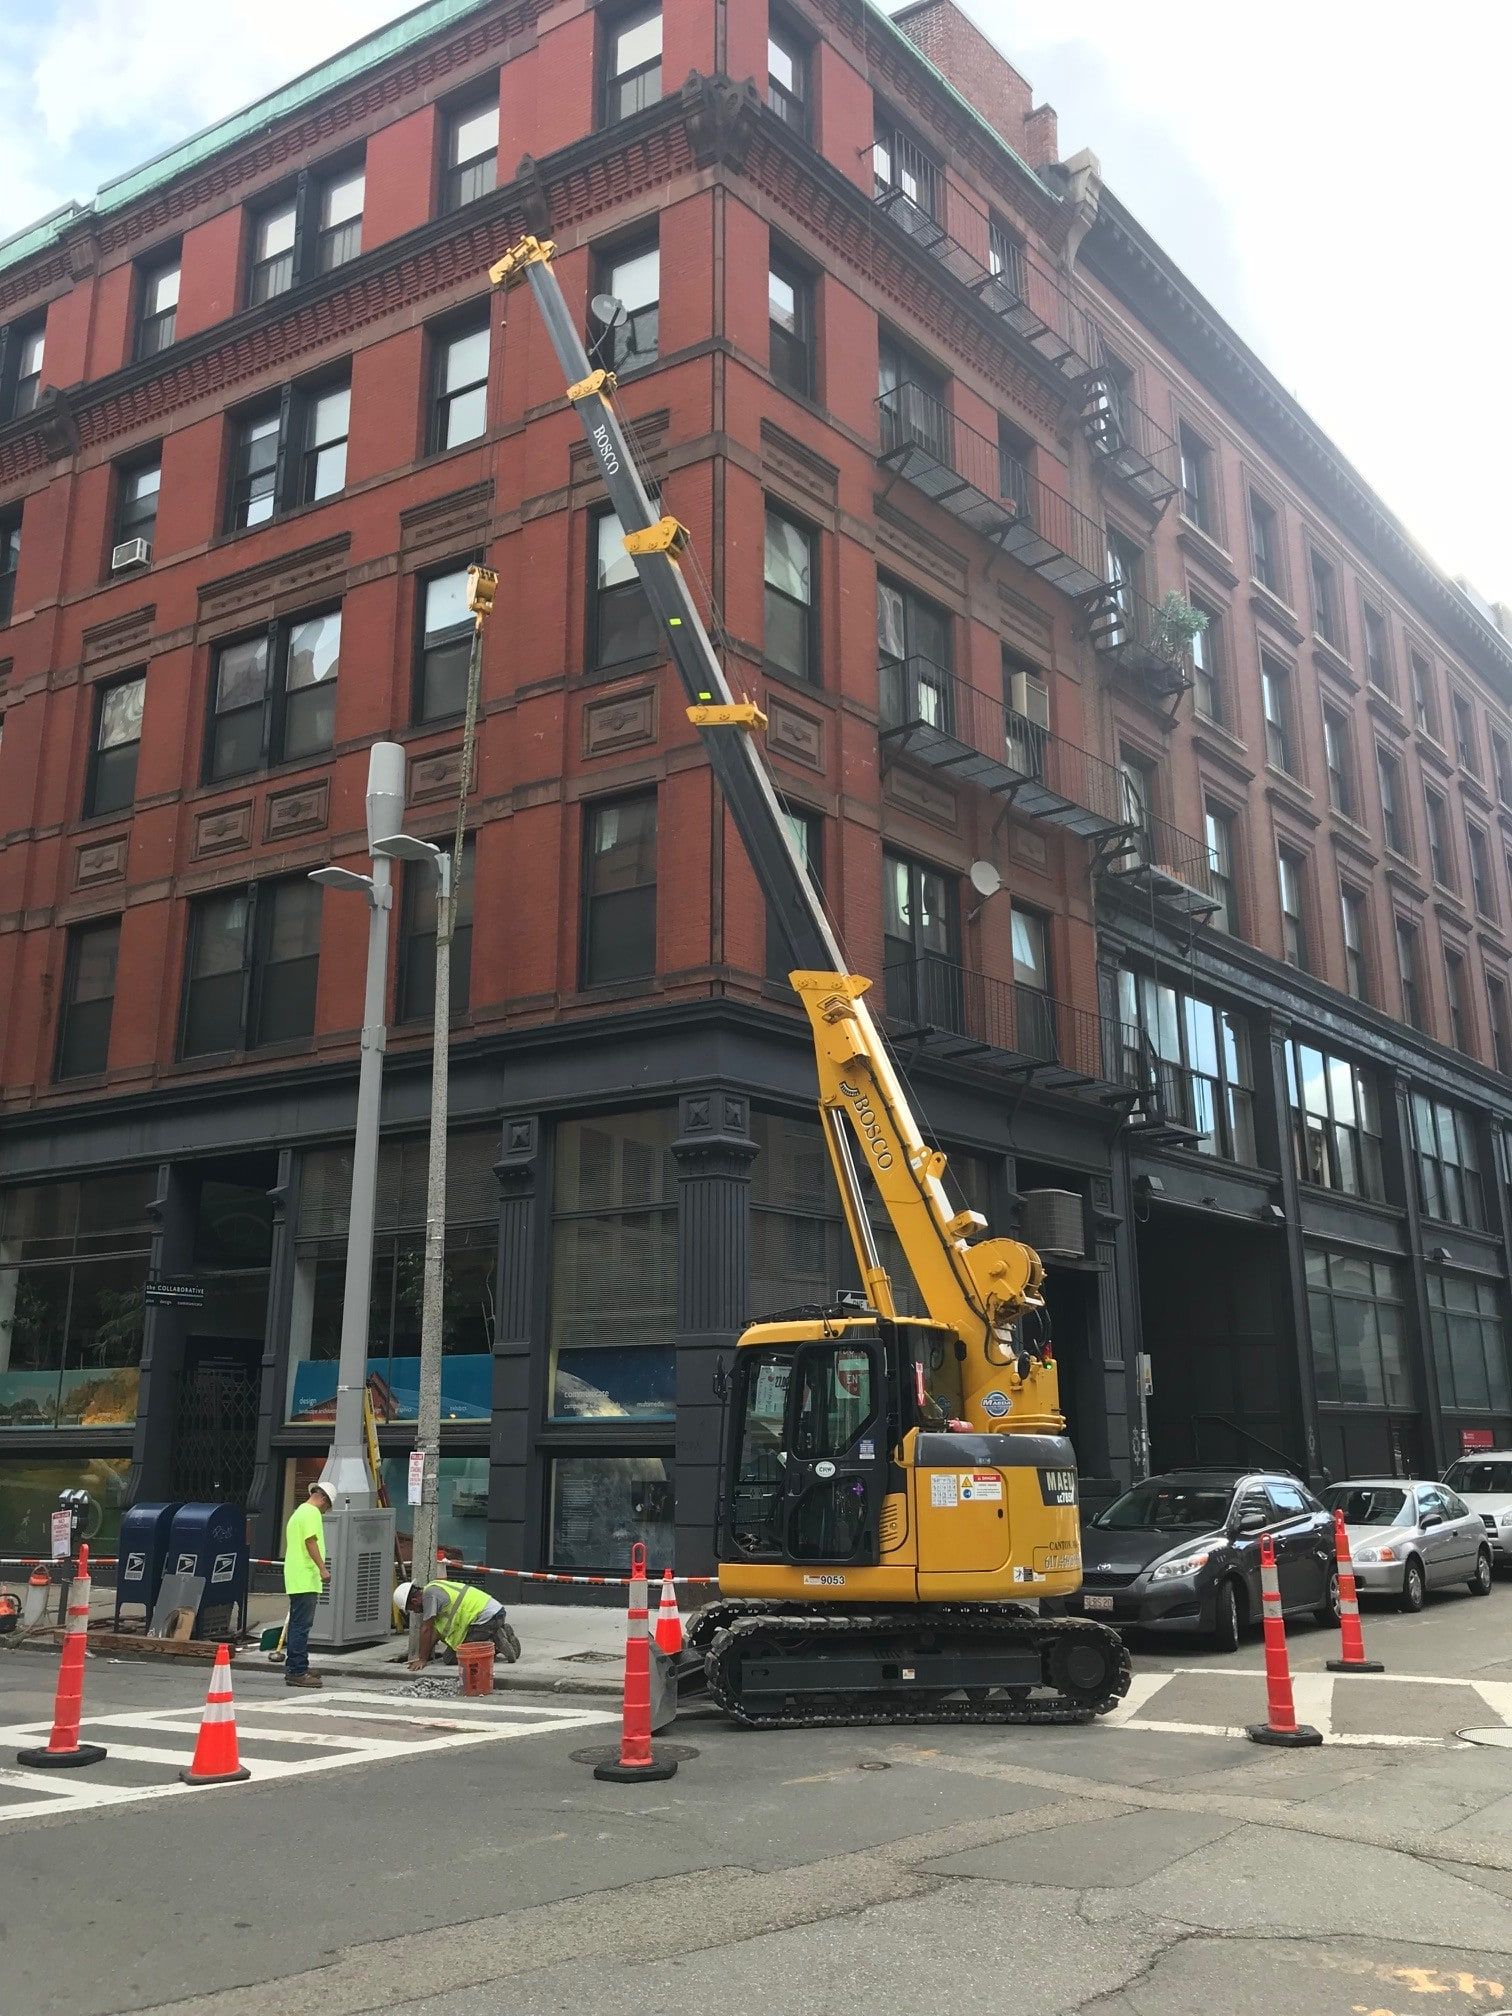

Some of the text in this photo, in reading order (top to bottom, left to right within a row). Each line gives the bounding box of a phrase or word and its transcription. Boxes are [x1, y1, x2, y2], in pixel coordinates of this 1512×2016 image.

[593, 424, 619, 475] BOSCO
[853, 1094, 894, 1170] BOSCO
[157, 1285, 205, 1294] COLLABORATIVE
[299, 1396, 317, 1407] design
[820, 1575, 845, 1585] 9053
